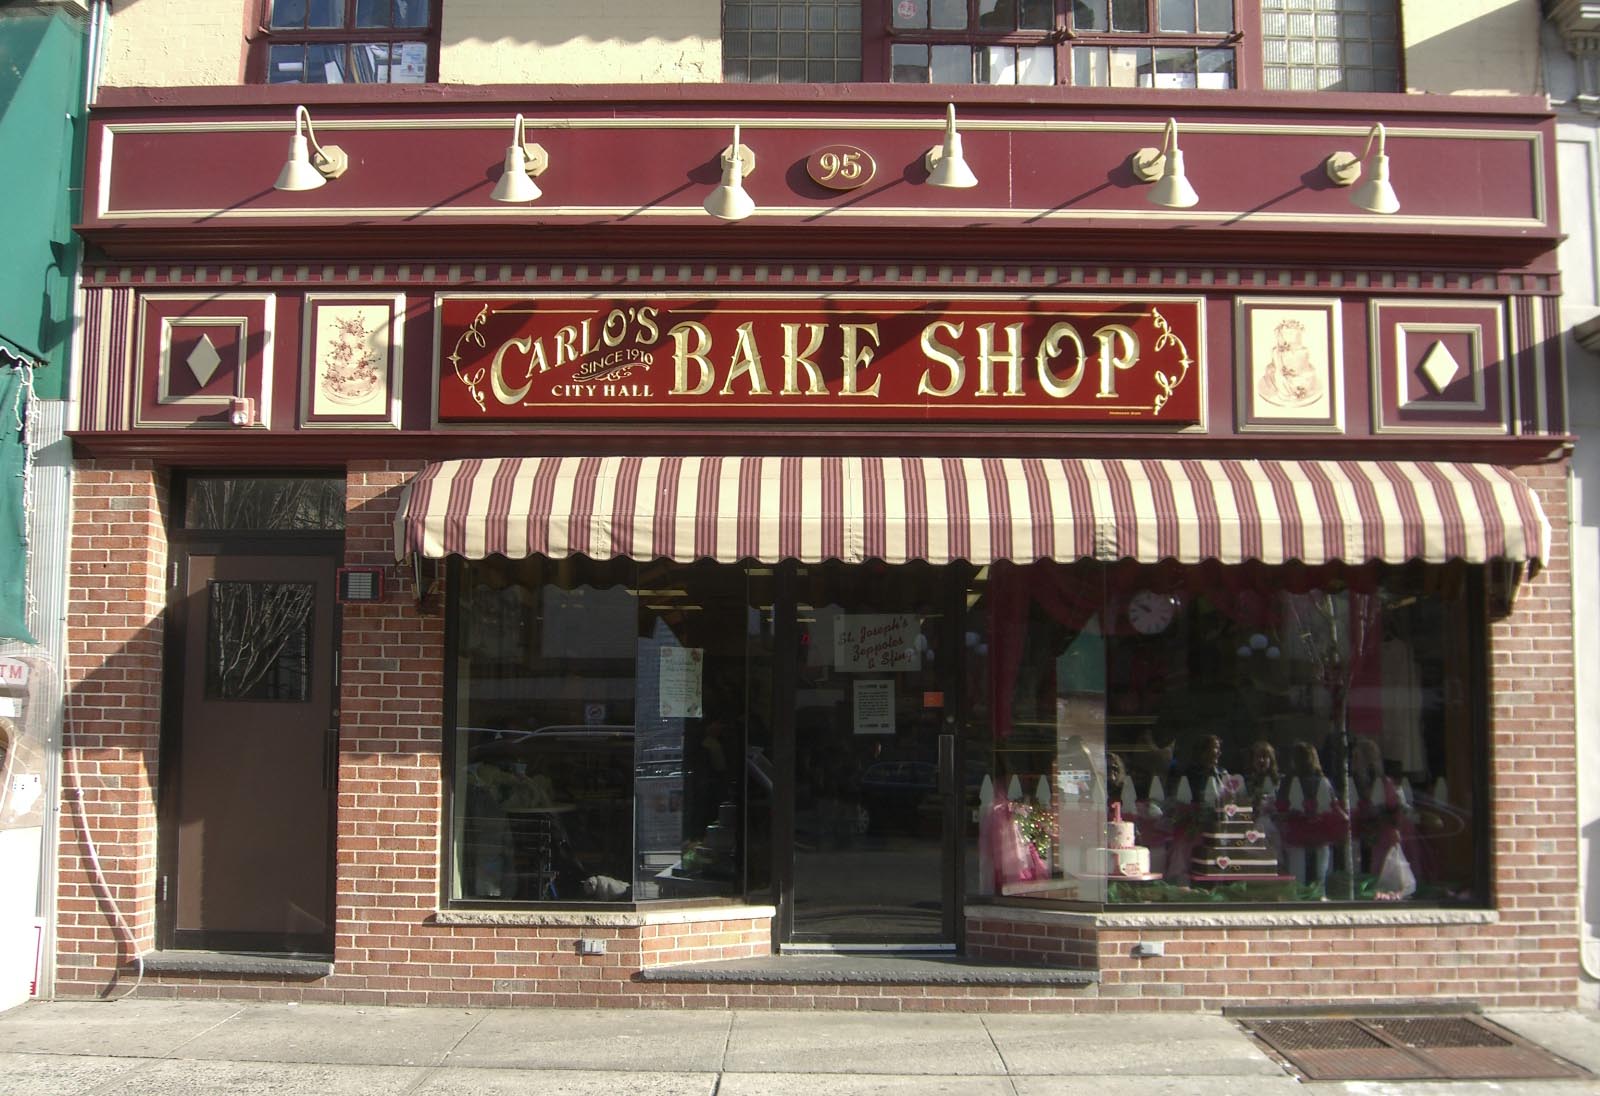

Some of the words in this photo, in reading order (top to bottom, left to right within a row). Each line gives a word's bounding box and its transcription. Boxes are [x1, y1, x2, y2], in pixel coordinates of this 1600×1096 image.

[820, 152, 862, 180] 95
[490, 306, 660, 405] CARLO'S
[667, 320, 882, 397] BAKE
[917, 320, 1141, 398] SHOP
[580, 350, 624, 375] SINCE
[626, 348, 654, 366] 1910
[551, 384, 596, 397] CITY
[603, 384, 655, 397] HALL
